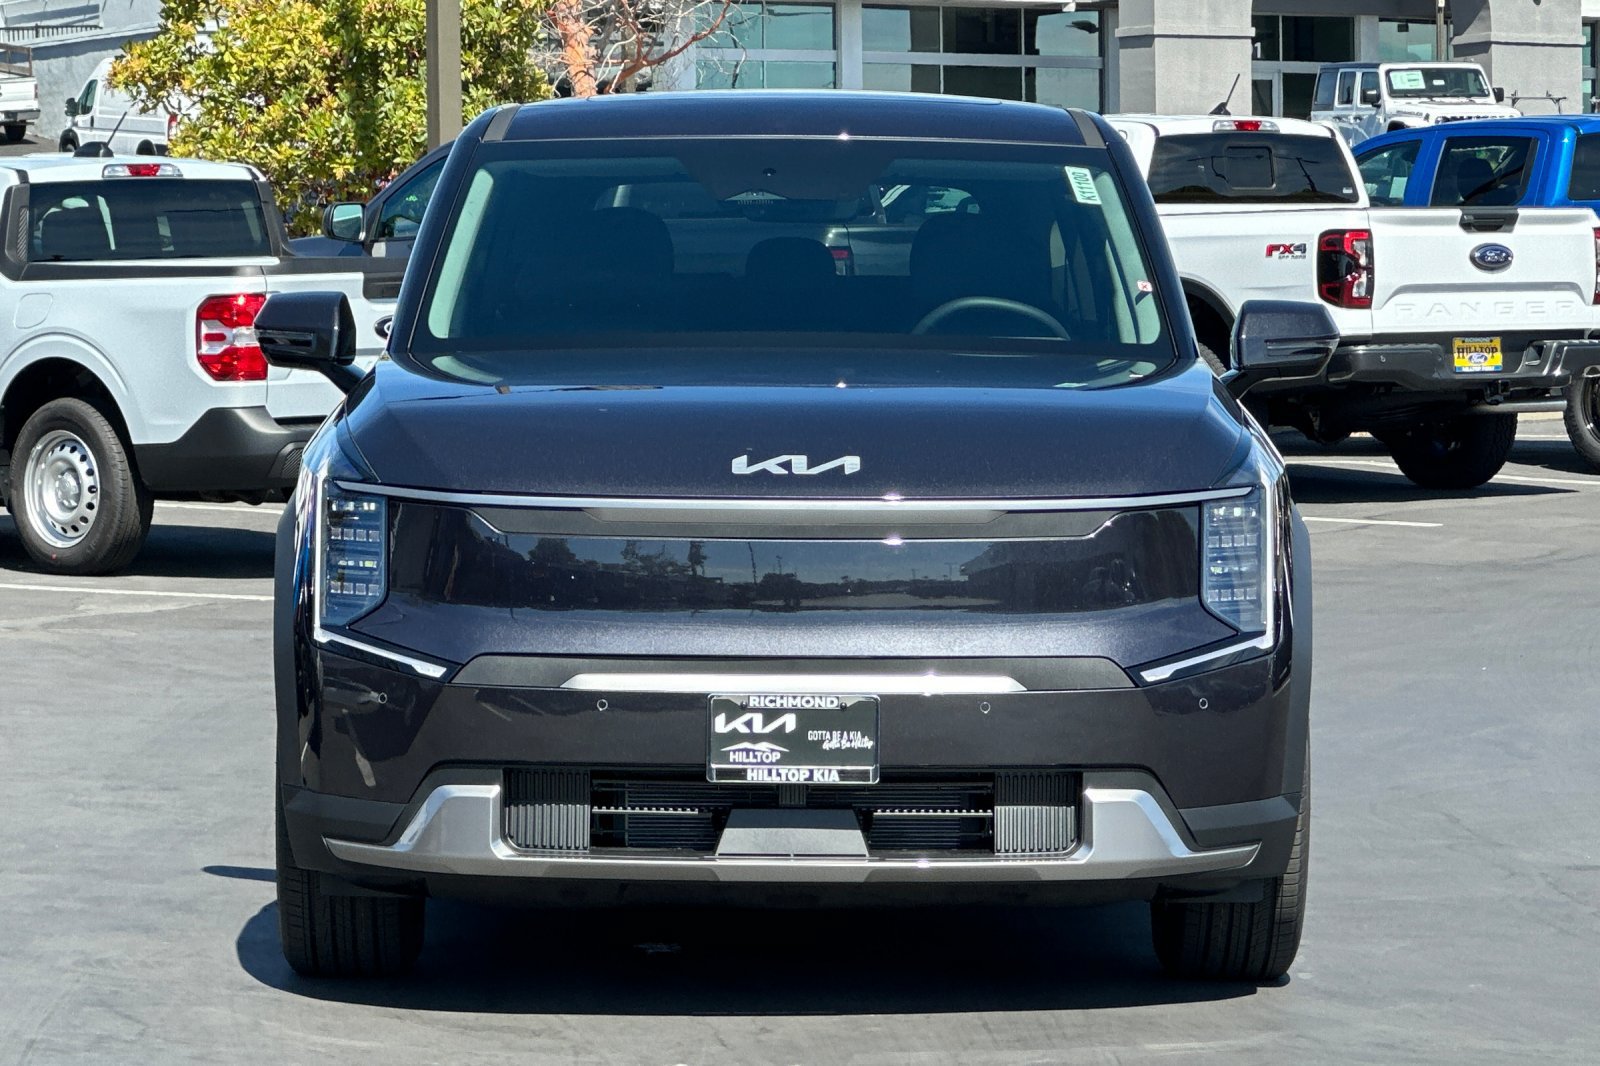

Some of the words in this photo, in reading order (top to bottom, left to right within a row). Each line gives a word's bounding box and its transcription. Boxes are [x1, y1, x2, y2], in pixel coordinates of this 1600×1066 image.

[1265, 243, 1307, 257] FX4
[1394, 300, 1575, 317] RANGER
[1456, 346, 1499, 360] HILLTOP
[731, 454, 861, 475] KIA
[749, 696, 839, 708] RICHMOND
[714, 712, 797, 734] KIA
[807, 730, 831, 741] GOTTA
[842, 730, 849, 741] A
[849, 730, 862, 741] KIA
[729, 751, 781, 763] HILLTOP
[746, 768, 811, 782] HILLTOP
[812, 769, 840, 782] KIA
